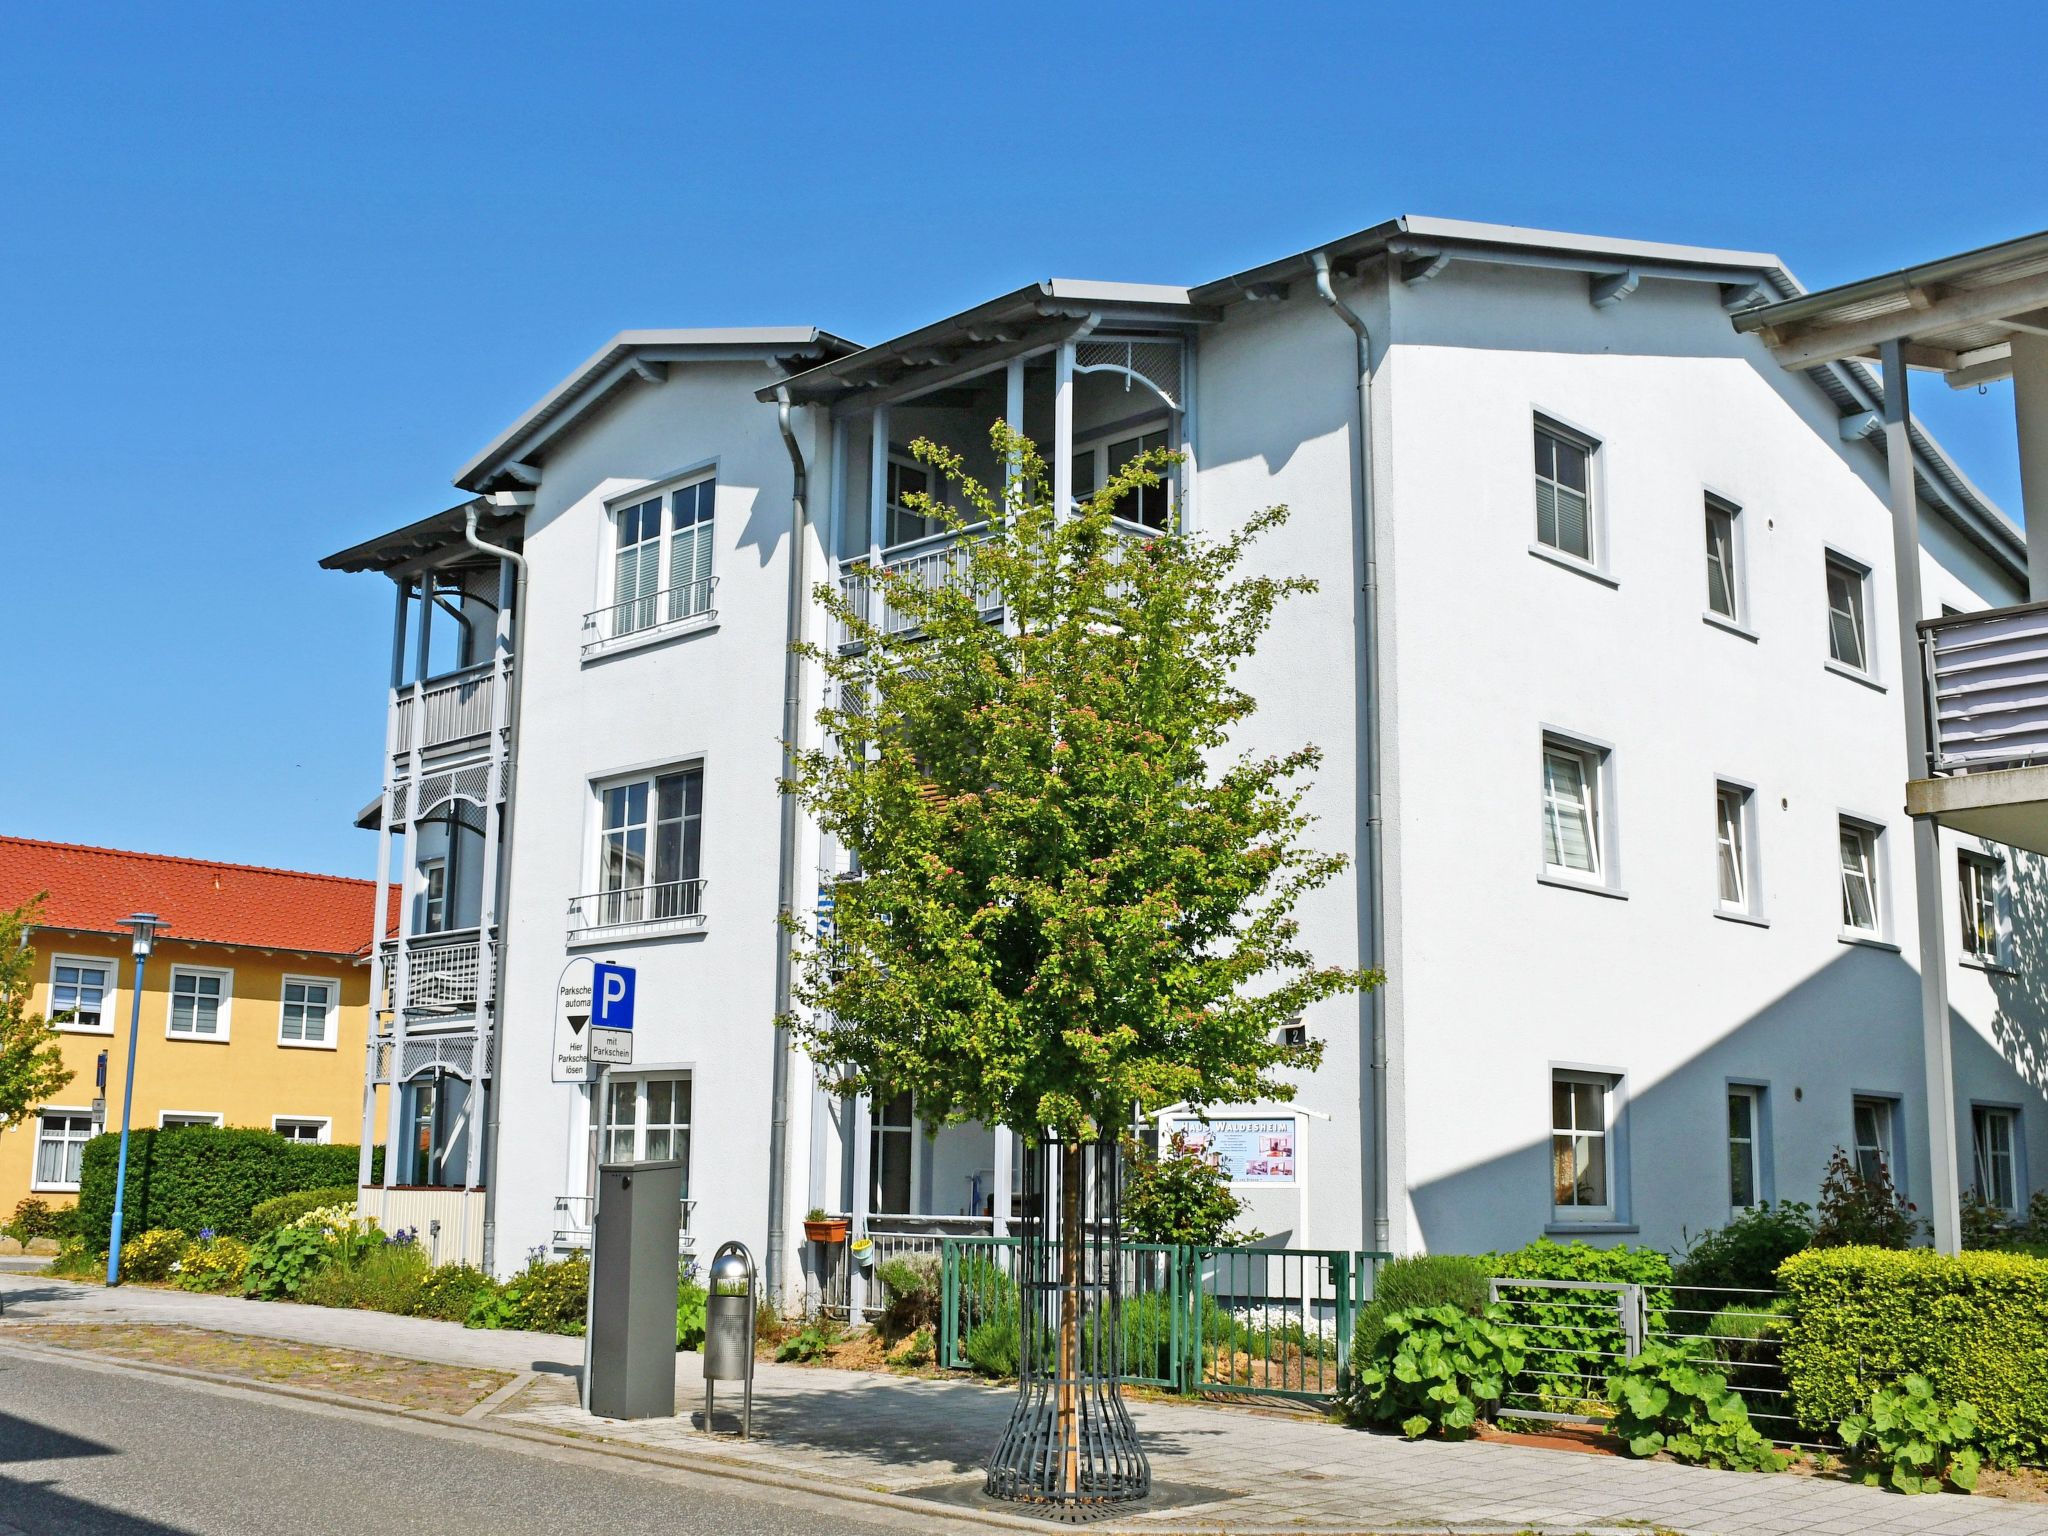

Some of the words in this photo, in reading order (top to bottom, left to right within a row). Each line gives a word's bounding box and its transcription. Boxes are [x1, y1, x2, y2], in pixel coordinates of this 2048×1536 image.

[560, 986, 592, 996] Parksche
[602, 972, 626, 1019] P
[565, 999, 591, 1008] automa
[570, 1043, 583, 1051] Hier
[593, 1046, 630, 1058] Parkschein
[558, 1054, 588, 1063] Parksche
[566, 1065, 583, 1074] lösen
[1215, 1121, 1288, 1133] WALDESHEIM
